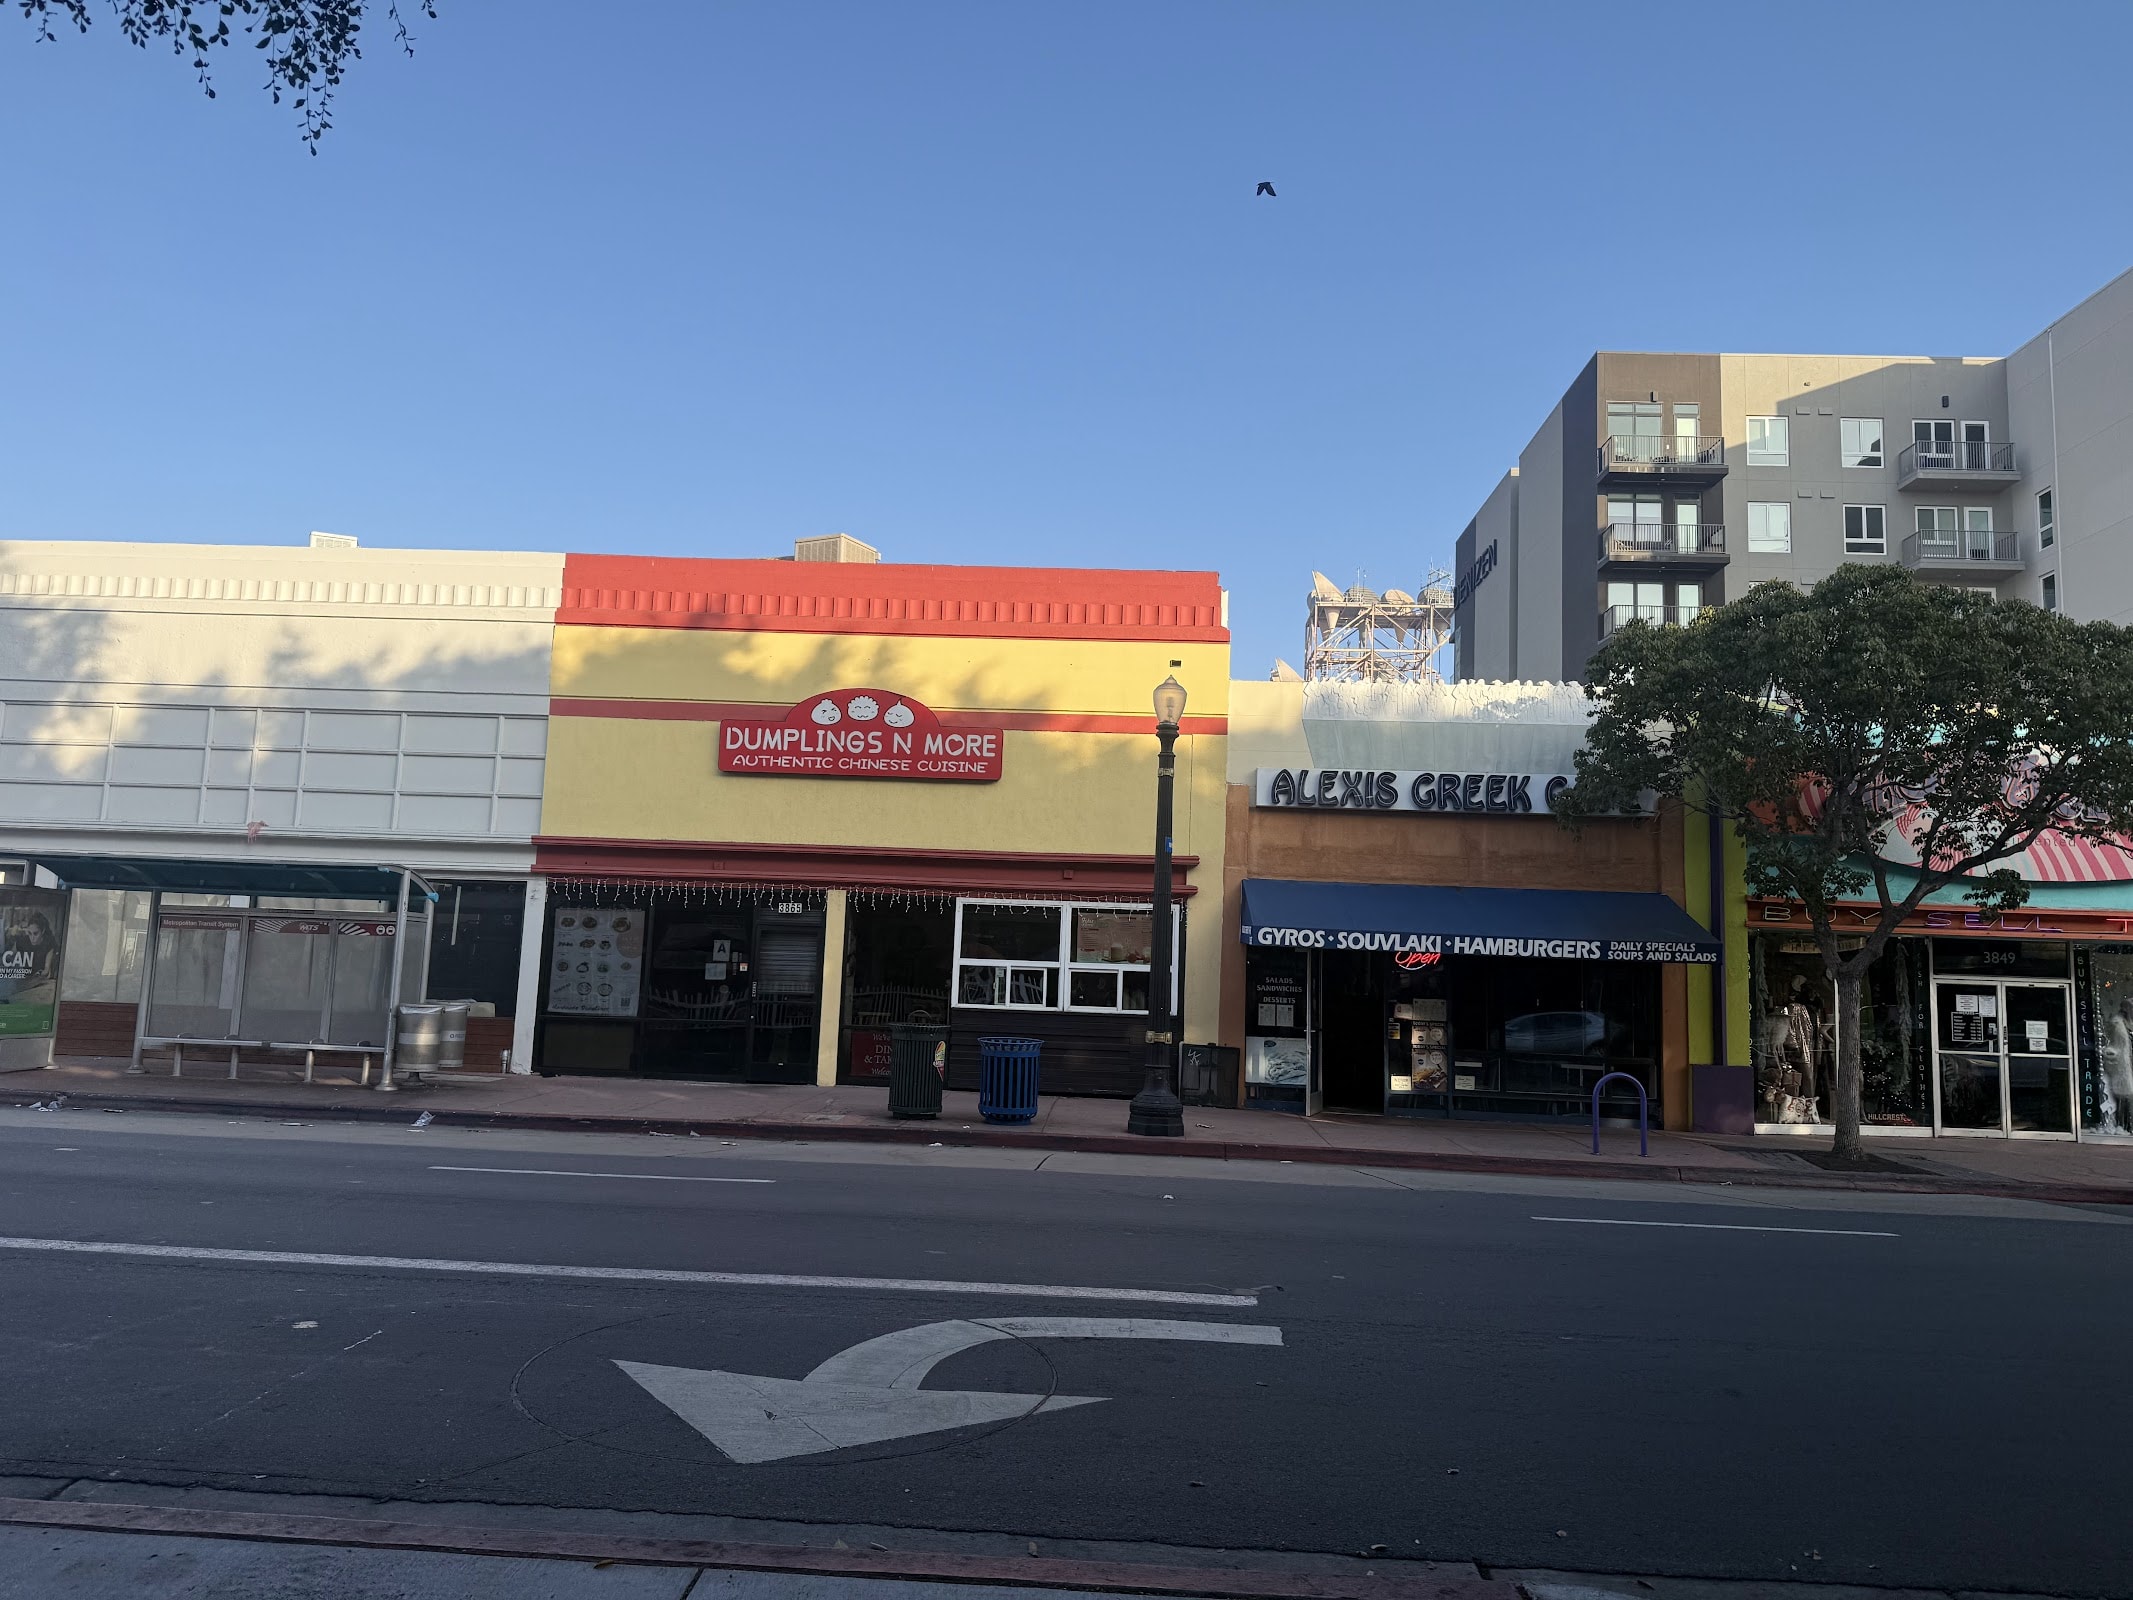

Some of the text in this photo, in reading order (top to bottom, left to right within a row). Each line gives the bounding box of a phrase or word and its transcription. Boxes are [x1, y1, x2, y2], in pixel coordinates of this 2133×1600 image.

[725, 727, 996, 757] DUMPLINGS N MORE
[732, 755, 988, 773] AUTHENTIC CHINESE CUISINE
[1271, 768, 1399, 809] ALEXIS
[1412, 772, 1532, 812] GREEK
[778, 902, 802, 913] 3865
[163, 919, 198, 927] Metropolitan
[198, 920, 217, 928] Transit
[1926, 912, 2065, 932] SELL
[717, 943, 727, 954] A
[1257, 926, 1325, 949] GYROS
[1336, 932, 1442, 953] SOUVLAKI
[1453, 937, 1601, 960] HAMBURGERS
[1610, 942, 1696, 953] DAILY SPECIALS
[2, 950, 34, 968] CAN
[1395, 951, 1441, 968] Open
[1607, 951, 1717, 963] SOUPS AND SALADS
[1983, 951, 2015, 966] 3849
[1257, 984, 1303, 993] SANDWICHES
[1263, 996, 1296, 1004] DESSERTS
[2076, 955, 2093, 1118] BUY SELL TRADE
[864, 1054, 873, 1064] &
[1867, 1113, 1904, 1121] HILLCREST
